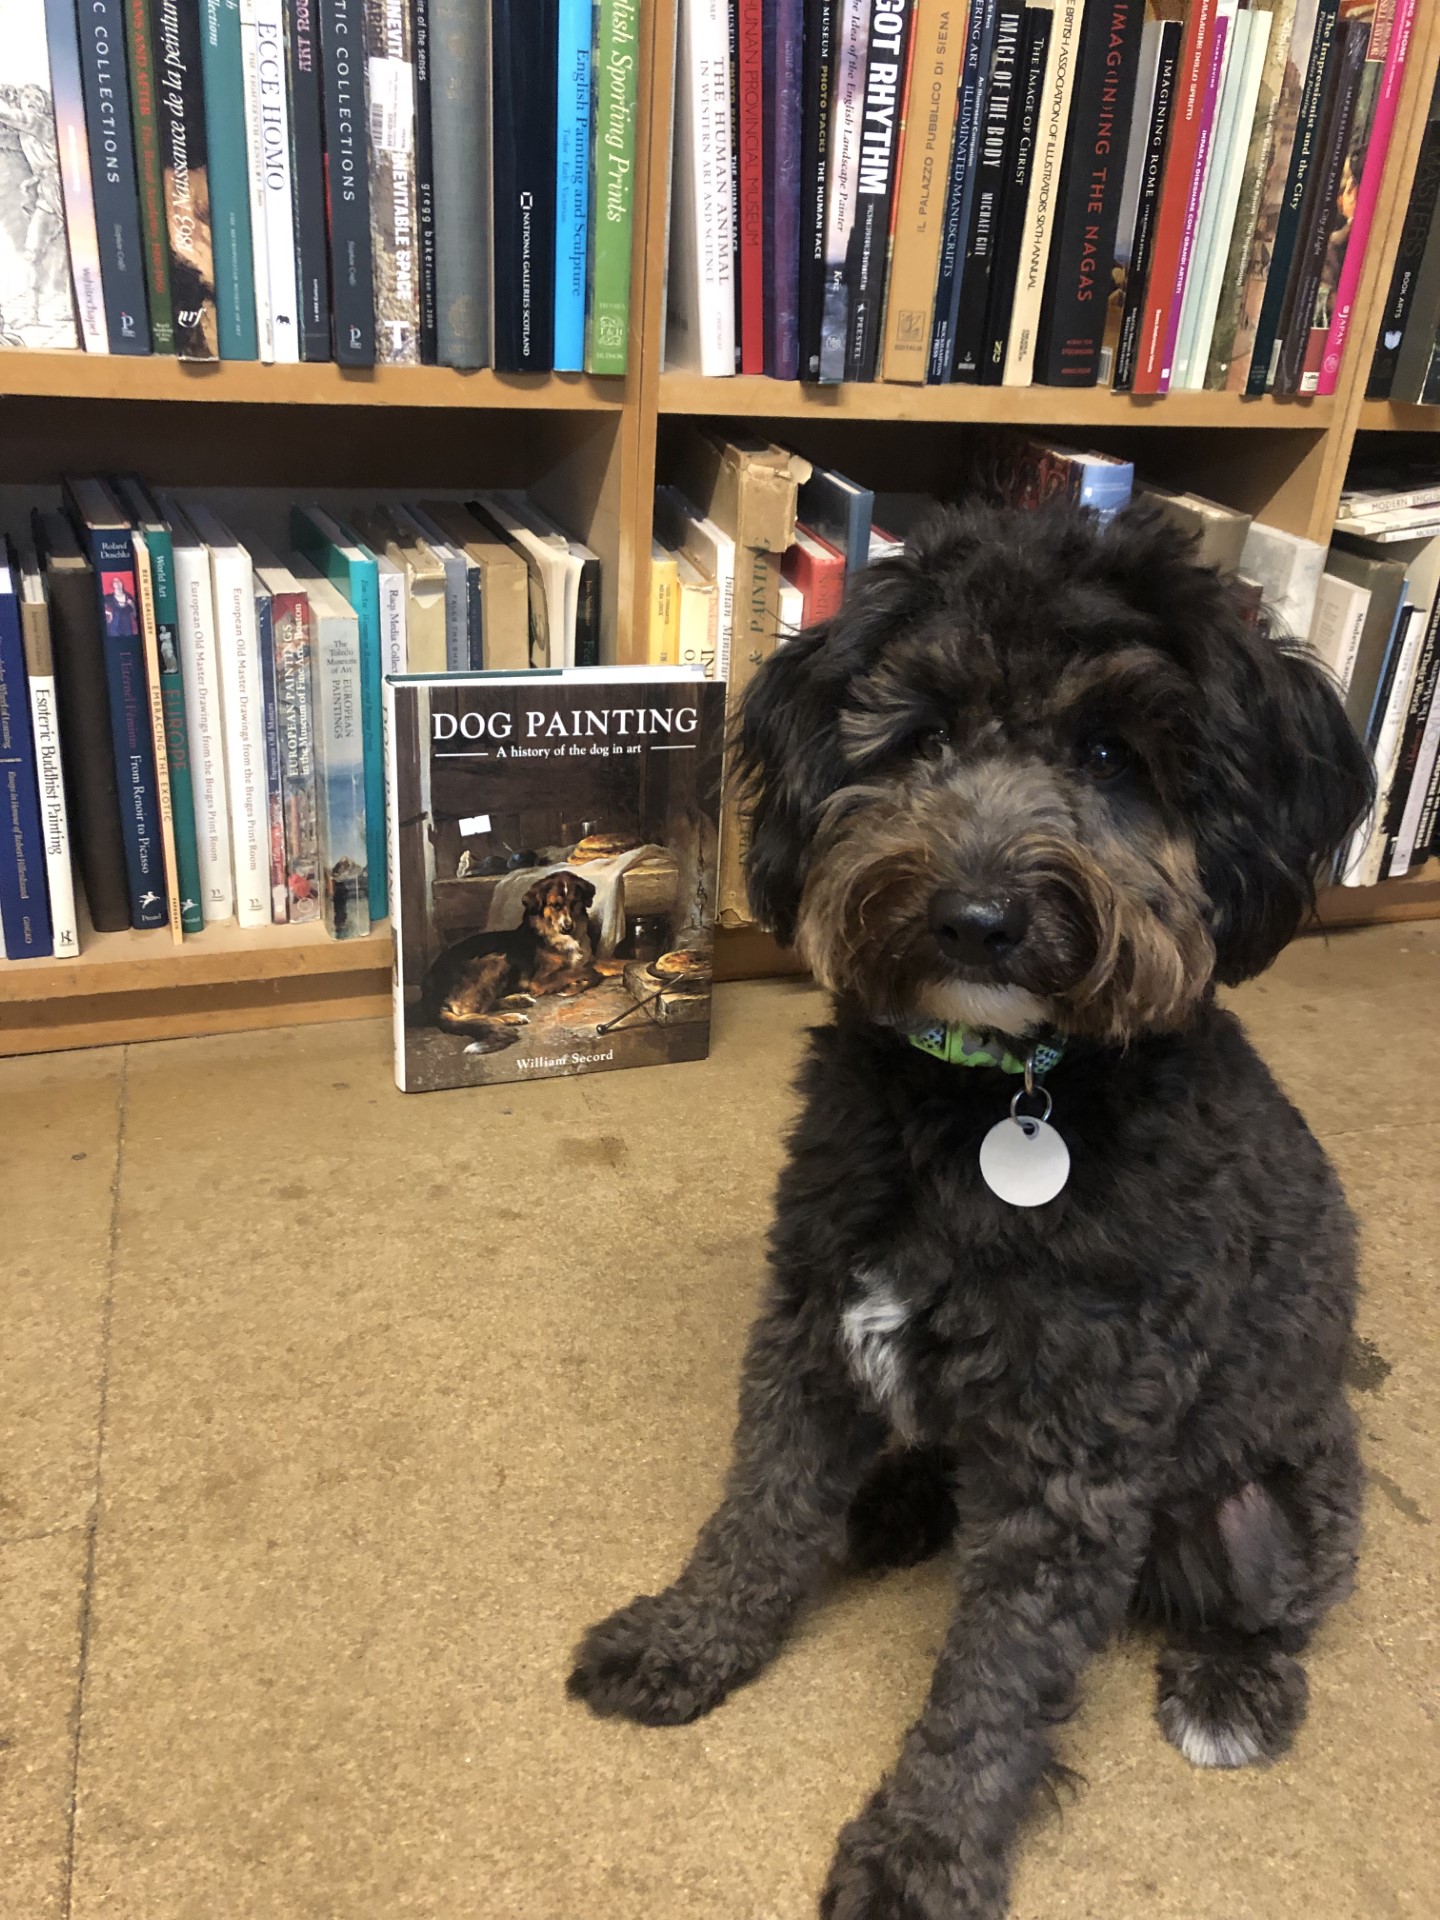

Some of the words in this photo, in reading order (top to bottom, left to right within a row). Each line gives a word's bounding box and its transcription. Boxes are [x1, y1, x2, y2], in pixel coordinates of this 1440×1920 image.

[611, 0, 635, 44] lish
[852, 0, 862, 12] he
[821, 6, 830, 57] MUSEUM
[849, 16, 861, 41] Idea
[936, 10, 950, 54] SIENA
[995, 13, 1020, 65] IMAGE
[1060, 6, 1076, 45] BRITISH
[1323, 11, 1336, 39] The
[257, 21, 281, 95] ECCE
[700, 60, 709, 77] IN
[846, 61, 858, 79] the
[847, 45, 858, 59] of
[933, 60, 945, 76] DI
[574, 49, 589, 107] English
[712, 56, 726, 101] THE
[820, 65, 829, 109] PHOTO
[993, 71, 1014, 91] OF
[1050, 47, 1069, 121] ASSOCIATION
[1304, 41, 1331, 129] Impressionist
[95, 27, 119, 183] COLLECTIONS
[606, 50, 633, 149] Sporting
[841, 83, 856, 125] English
[925, 82, 943, 150] PUBBLICO
[990, 95, 1010, 121] THE
[1151, 58, 1173, 146] IMAGINING
[702, 84, 711, 153] WESTERN
[744, 70, 759, 171] PROVINCIAL
[819, 113, 828, 153] PACKS
[859, 62, 897, 195] RHYTHM
[1047, 124, 1059, 141] OF
[1332, 86, 1353, 167] IMPRESSIONIST
[263, 104, 286, 191] HOMO
[572, 117, 588, 184] Painting
[714, 111, 727, 194] HUMAN
[839, 129, 853, 190] Landscape
[983, 126, 1005, 168] BODY
[1197, 129, 1207, 159] IMPARA
[1300, 131, 1313, 156] and
[703, 161, 712, 185] ART
[817, 161, 827, 182] THE
[918, 156, 934, 216] PALAZZO
[1038, 142, 1056, 213] ILLUSTRATORS
[1144, 154, 1159, 198] ROME
[1296, 159, 1309, 180] the
[1325, 172, 1337, 202] PARIS
[391, 152, 410, 246] INEVITABLE
[421, 184, 431, 223] gregg
[572, 190, 587, 219] and
[606, 155, 629, 223] Prints
[1087, 167, 1108, 213] THE
[1189, 169, 1202, 212] DISEGNARE
[1289, 182, 1305, 210] City
[704, 192, 713, 223] AND
[745, 177, 760, 246] MUSEUM
[816, 186, 825, 229] HUMAN
[836, 192, 848, 233] Painter
[976, 193, 993, 234] MICHAEL
[1187, 213, 1195, 231] CON
[1319, 209, 1330, 224] City
[522, 212, 532, 260] NATIONAL
[717, 203, 730, 286] ANIMAL
[916, 222, 926, 233] IL
[1034, 214, 1047, 244] SIXTH
[1317, 226, 1327, 235] of
[425, 231, 433, 267] baker
[568, 225, 587, 297] Sculpture
[705, 228, 714, 284] SCIENCE
[814, 233, 823, 260] FACE
[974, 237, 987, 257] GILL
[1078, 225, 1101, 301] NAGAS
[1181, 236, 1191, 265] GRANDI
[1313, 236, 1324, 256] Light
[395, 249, 411, 301] SPACE
[522, 262, 532, 308] GALLERIES
[1027, 246, 1041, 291] ANNUAL
[1175, 265, 1185, 294] ARTISTI
[1399, 271, 1412, 295] BOOK
[1394, 297, 1405, 319] ARTS
[522, 310, 532, 356] SCOTLAND
[854, 316, 864, 359] PRESTEL
[1336, 313, 1349, 345] JAPAN
[102, 541, 127, 550] Roland
[156, 555, 168, 581] World
[749, 537, 771, 633] PAINTING
[157, 583, 168, 599] Art
[190, 580, 203, 629] European
[387, 590, 400, 611] Raqs
[723, 576, 735, 617] Indian
[231, 587, 244, 637] European
[294, 603, 304, 640] Boston
[390, 613, 401, 642] Media
[193, 631, 204, 649] Old
[235, 639, 246, 657] Old
[333, 640, 347, 648] The
[1348, 612, 1364, 652] Modern
[195, 652, 207, 684] Master
[281, 624, 295, 699] PAINTINGS
[327, 658, 357, 666] Museum
[390, 643, 401, 674] Collect
[720, 624, 732, 681] Miniatur
[748, 649, 762, 667] &
[237, 659, 248, 693] Master
[295, 669, 305, 691] Fine
[1341, 655, 1354, 688] Scand
[197, 687, 210, 733] Drawings
[296, 691, 307, 703] of
[332, 679, 343, 739] PAINTINGS
[342, 679, 354, 738] EUROPEAN
[36, 689, 53, 742] Esoteric
[152, 685, 165, 753] EMBRACING
[162, 688, 187, 772] EUROPE
[238, 696, 250, 741] Drawings
[267, 701, 275, 730] Masters
[297, 703, 308, 746] Museum
[433, 712, 513, 740] DOG
[526, 707, 698, 738] PAINTING
[202, 735, 212, 758] from
[241, 743, 252, 766] from
[268, 731, 276, 747] Old
[285, 702, 298, 777] EUROPEAN
[298, 746, 309, 763] the
[496, 746, 508, 758] A
[511, 744, 551, 759] history
[553, 744, 566, 756] of
[569, 743, 587, 756] the
[590, 743, 610, 757] dog
[612, 742, 623, 754] in
[626, 743, 642, 754] art
[41, 745, 59, 800] Buddhist
[158, 756, 168, 777] THE
[204, 760, 213, 776] the
[244, 767, 253, 784] the
[269, 748, 278, 781] European
[299, 763, 309, 776] in
[160, 781, 171, 823] EXOTIC
[203, 778, 217, 809] Bruges
[243, 786, 255, 817] Bruges
[46, 802, 63, 855] Painting
[208, 811, 217, 834] Print
[248, 819, 257, 843] Print
[208, 836, 219, 862] Room
[249, 845, 258, 871] Room
[516, 1056, 567, 1070] William
[571, 1048, 614, 1064] Secord
